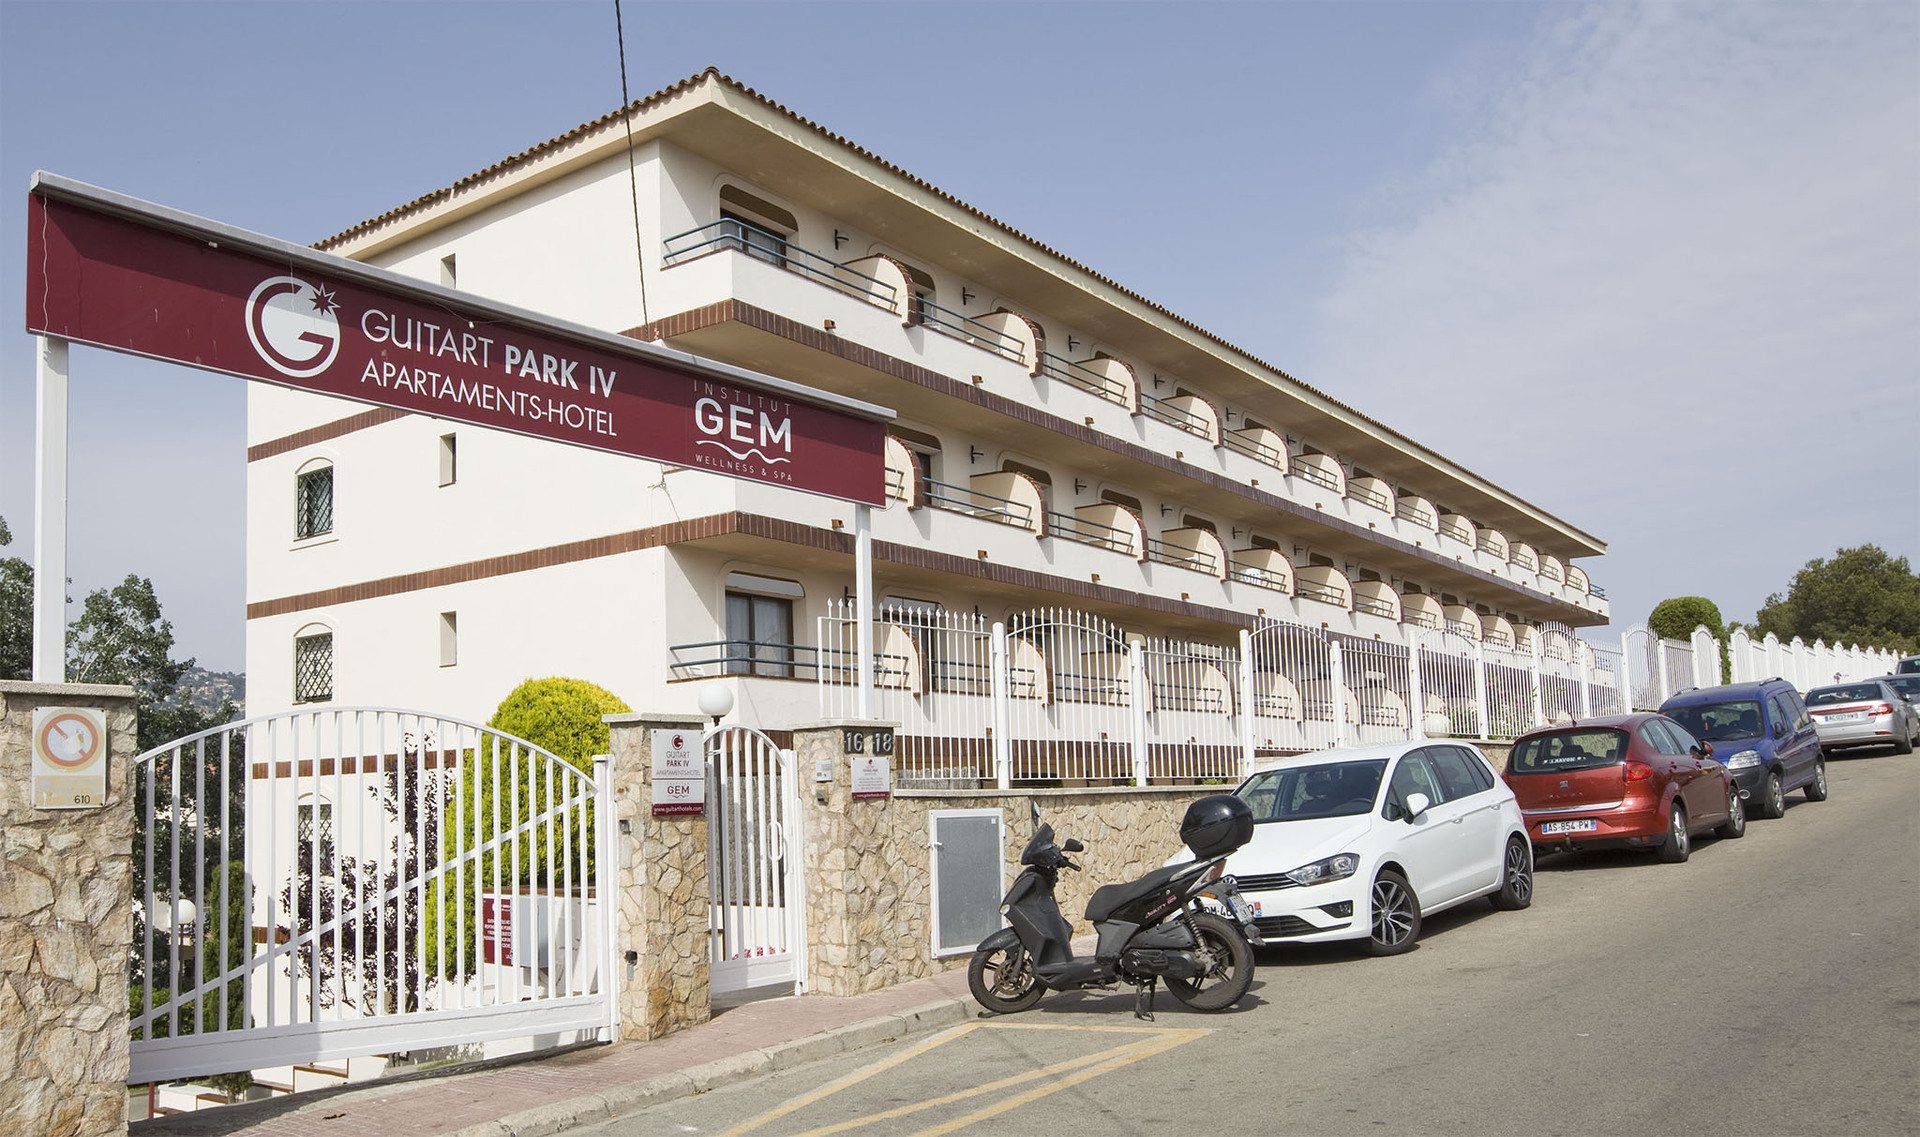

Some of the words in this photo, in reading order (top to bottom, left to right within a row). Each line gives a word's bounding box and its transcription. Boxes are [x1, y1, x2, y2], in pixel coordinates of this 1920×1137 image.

[361, 309, 493, 368] GUITART
[505, 344, 579, 391] PARK
[590, 365, 616, 398] IV
[361, 357, 617, 437] APARTAMENTS-HOTEL
[694, 380, 791, 415] INSTITUT
[695, 397, 791, 453] GEM
[695, 454, 755, 474] WELLNESS
[761, 468, 767, 476] &
[773, 471, 792, 481] SPA
[666, 751, 690, 759] GUITART
[846, 732, 863, 752] 16
[875, 733, 892, 753] 18
[74, 795, 91, 804] 610
[667, 785, 690, 794] GEM
